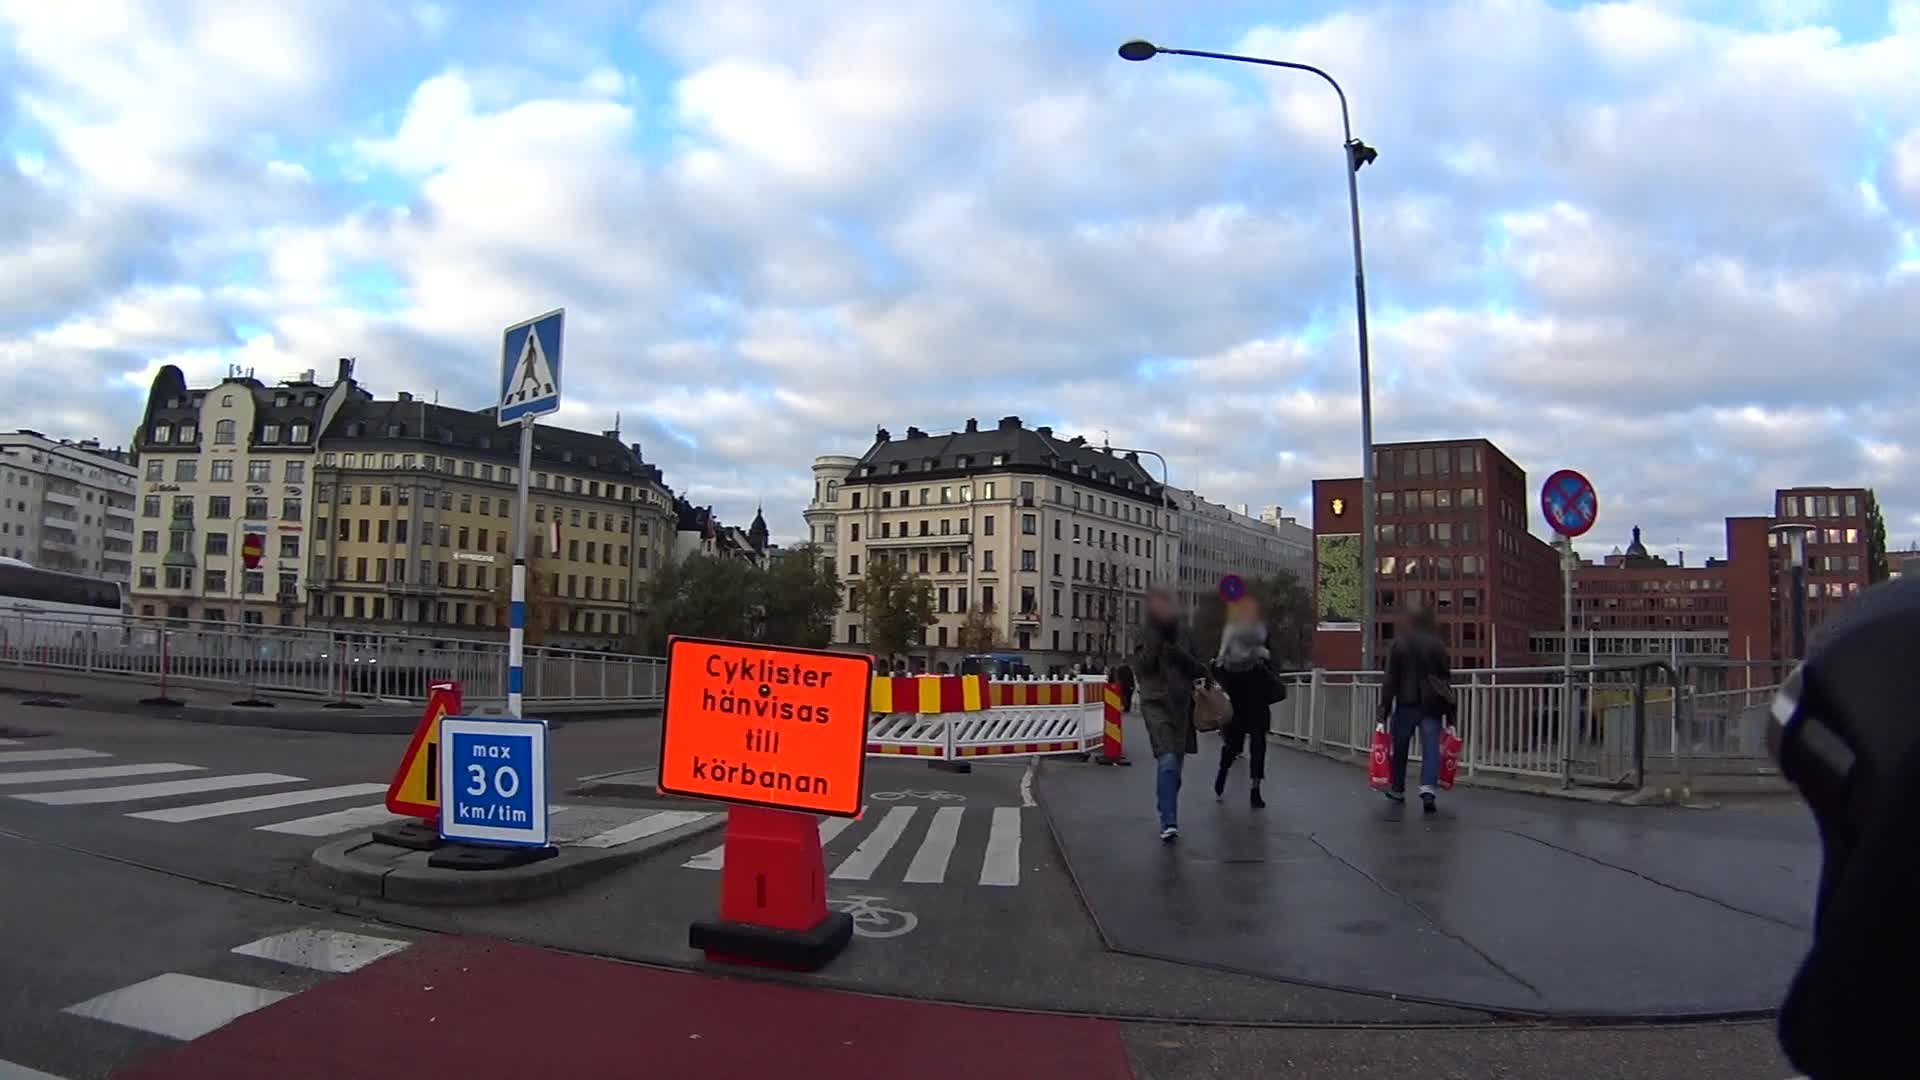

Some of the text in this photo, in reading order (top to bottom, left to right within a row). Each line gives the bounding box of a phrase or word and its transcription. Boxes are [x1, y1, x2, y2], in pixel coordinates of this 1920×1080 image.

[706, 654, 832, 688] Cyklister
[702, 688, 830, 724] hänvisas
[472, 744, 511, 759] max
[745, 729, 780, 753] till
[466, 764, 519, 798] 30
[692, 755, 828, 795] körbanan
[459, 802, 527, 822] km/tim
